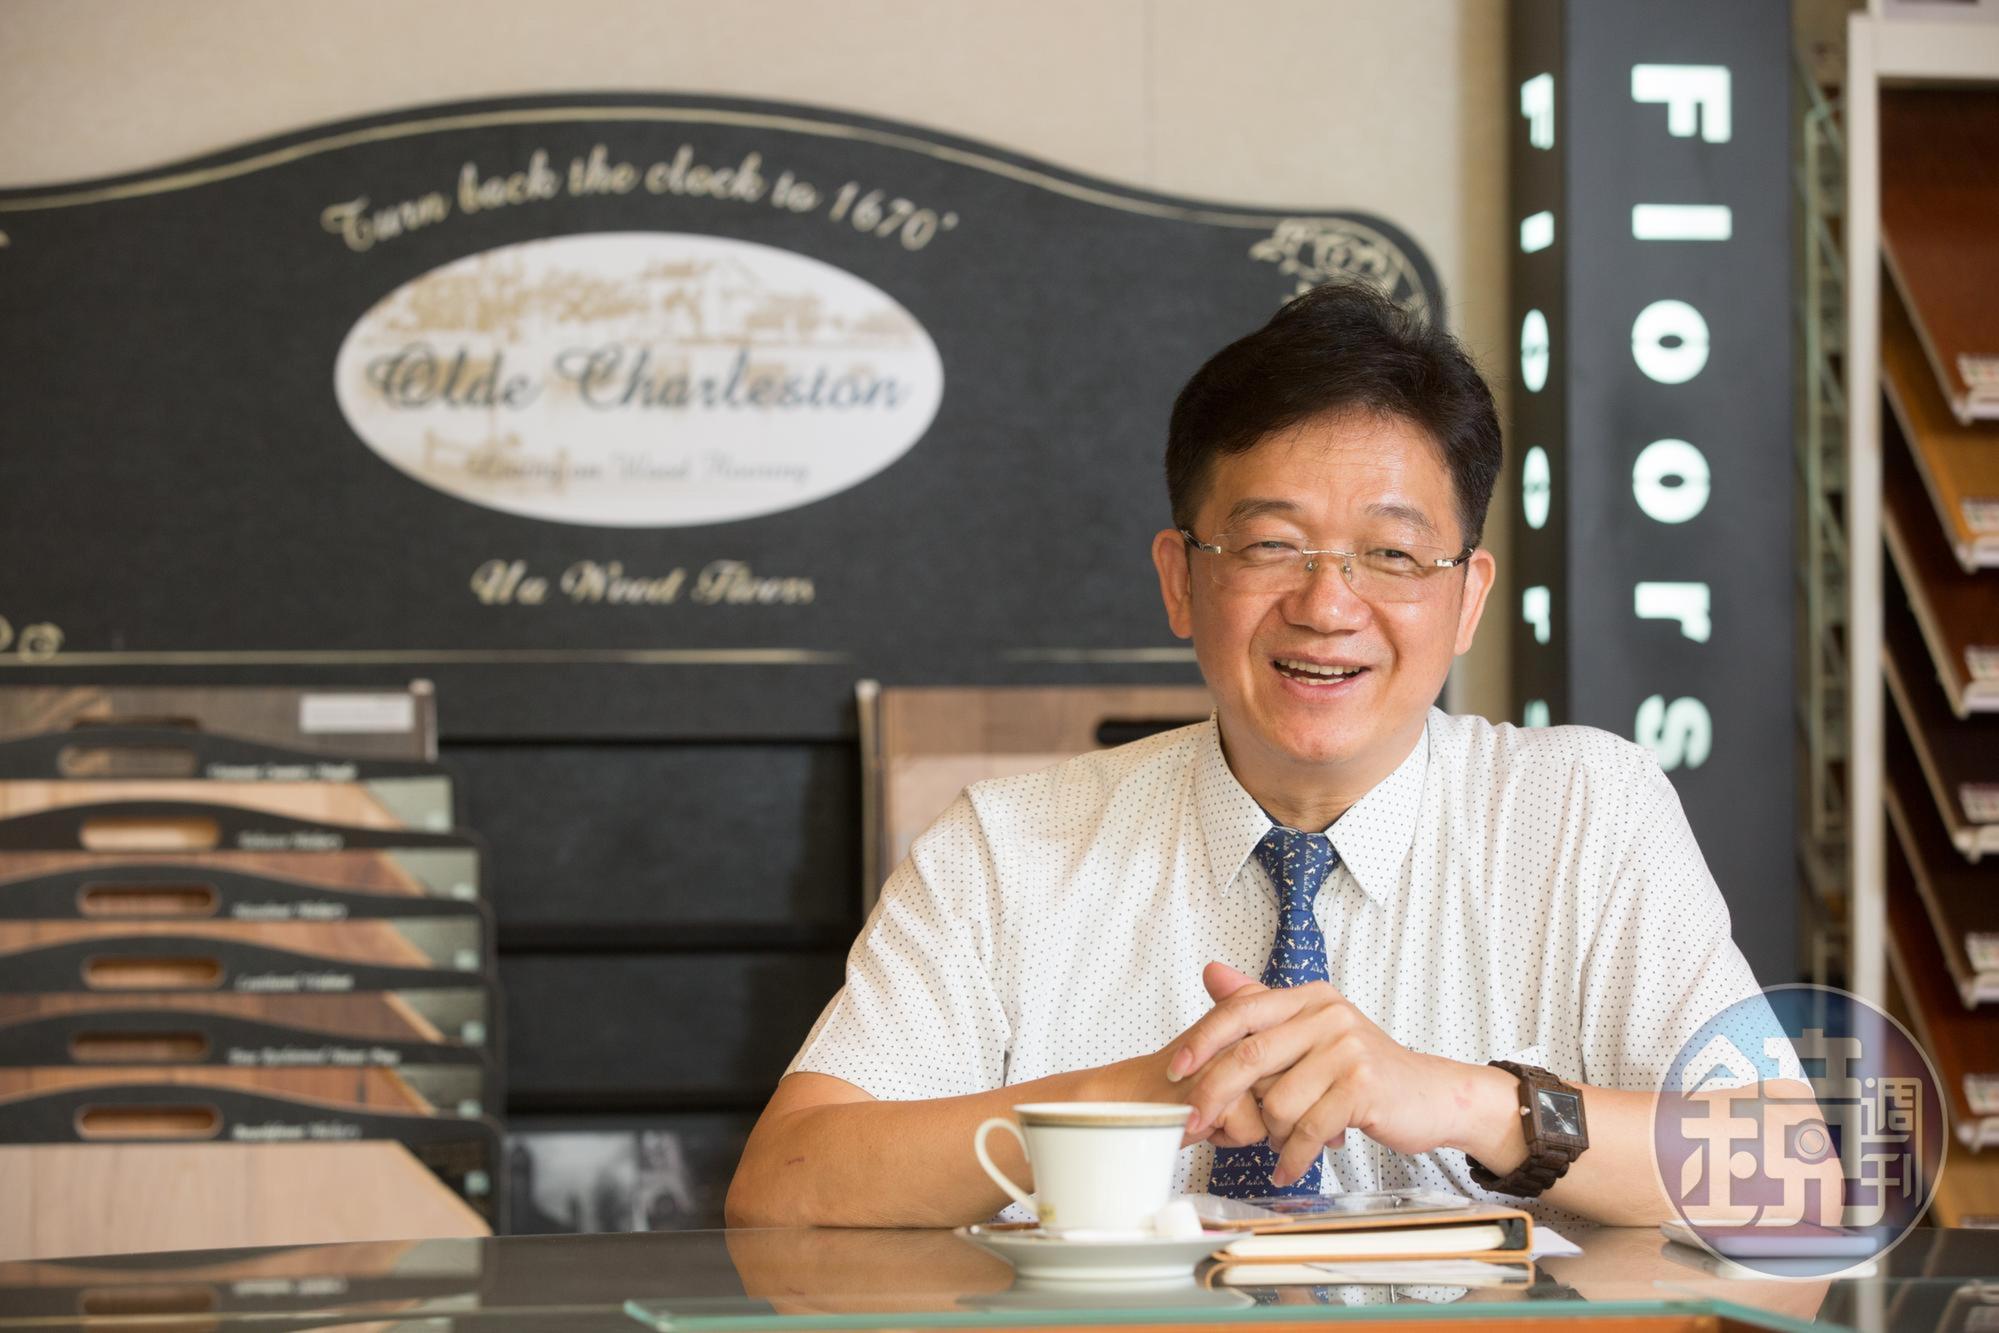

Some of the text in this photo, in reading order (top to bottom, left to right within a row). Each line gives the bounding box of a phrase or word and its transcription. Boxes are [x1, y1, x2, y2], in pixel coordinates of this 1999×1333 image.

[320, 196, 450, 252] Turn
[457, 149, 560, 214] back
[567, 144, 639, 196] the
[644, 143, 767, 203] clock
[770, 168, 821, 213] to
[366, 340, 911, 412] Olde Charleston
[1630, 63, 1732, 772] Floors
